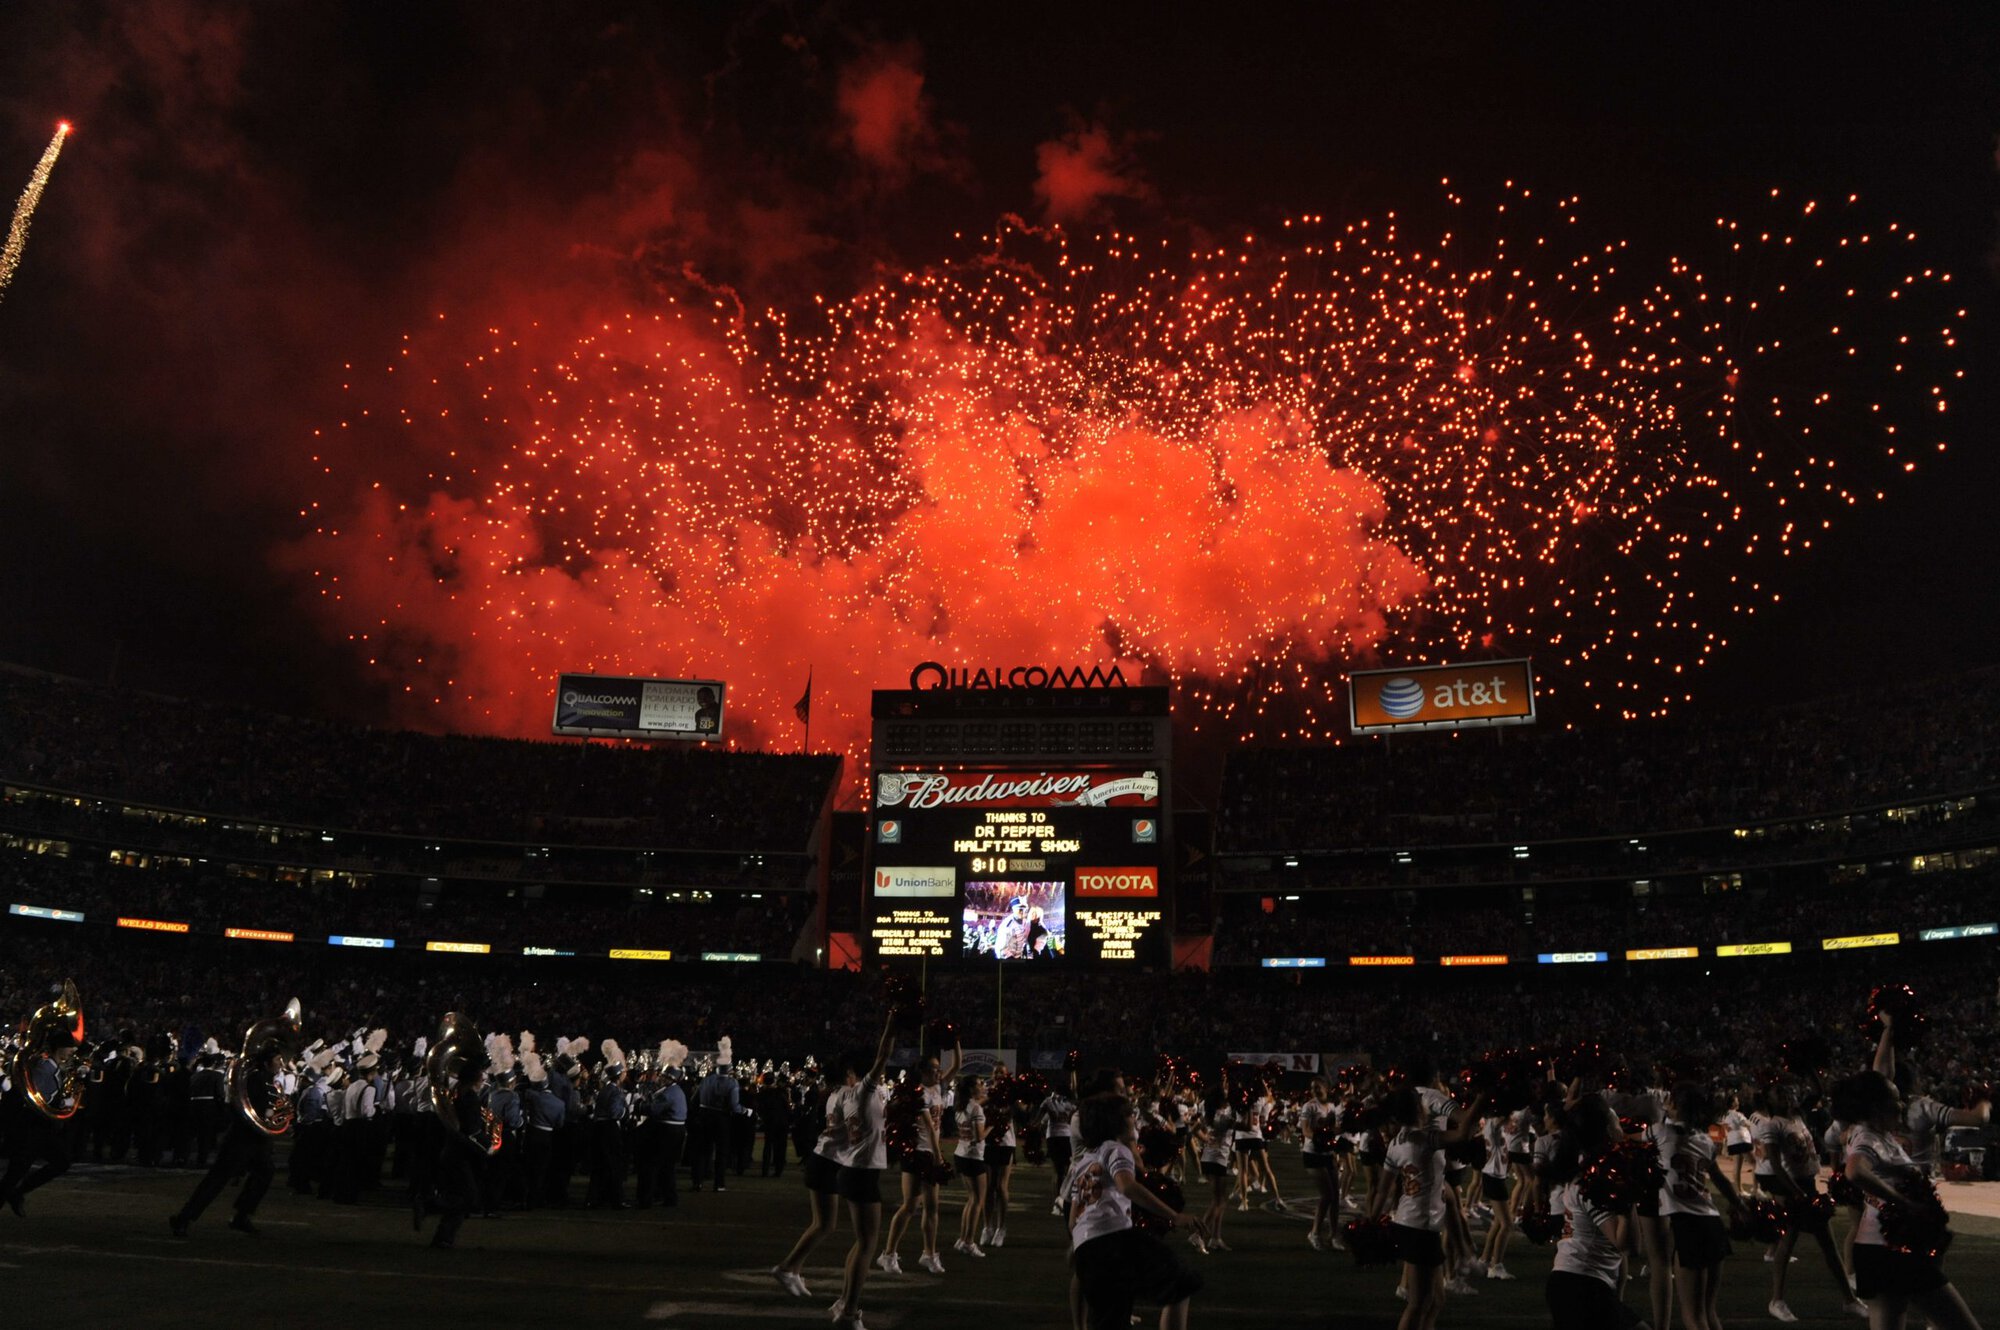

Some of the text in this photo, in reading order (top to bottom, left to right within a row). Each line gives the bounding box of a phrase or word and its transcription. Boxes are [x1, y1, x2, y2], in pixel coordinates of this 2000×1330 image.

[910, 662, 1128, 690] QUALCOMM
[1433, 676, 1507, 708] at&t
[563, 691, 637, 707] QUALCOMM
[644, 703, 695, 712] HEALTH
[647, 721, 689, 729] www.pph.org
[901, 772, 1091, 809] Budweiser
[1092, 784, 1130, 801] American
[1131, 782, 1156, 792] Lager
[985, 812, 1046, 823] THANKS TO
[975, 825, 1055, 838] DR PEPPER
[954, 840, 1080, 852] HALFTIME SHOW
[895, 876, 954, 887] UnionBank
[1078, 875, 1154, 890] TOYOTA
[1075, 911, 1161, 920] THE PACIFIC LIFE
[119, 918, 189, 932] WELLS FARGO
[872, 929, 915, 938] HERCULES
[432, 942, 484, 953] CYMER
[931, 946, 943, 955] CA
[1551, 952, 1597, 963] GEICO
[1636, 949, 1689, 960] CYMER
[1350, 956, 1414, 965] WELLS FARGO
